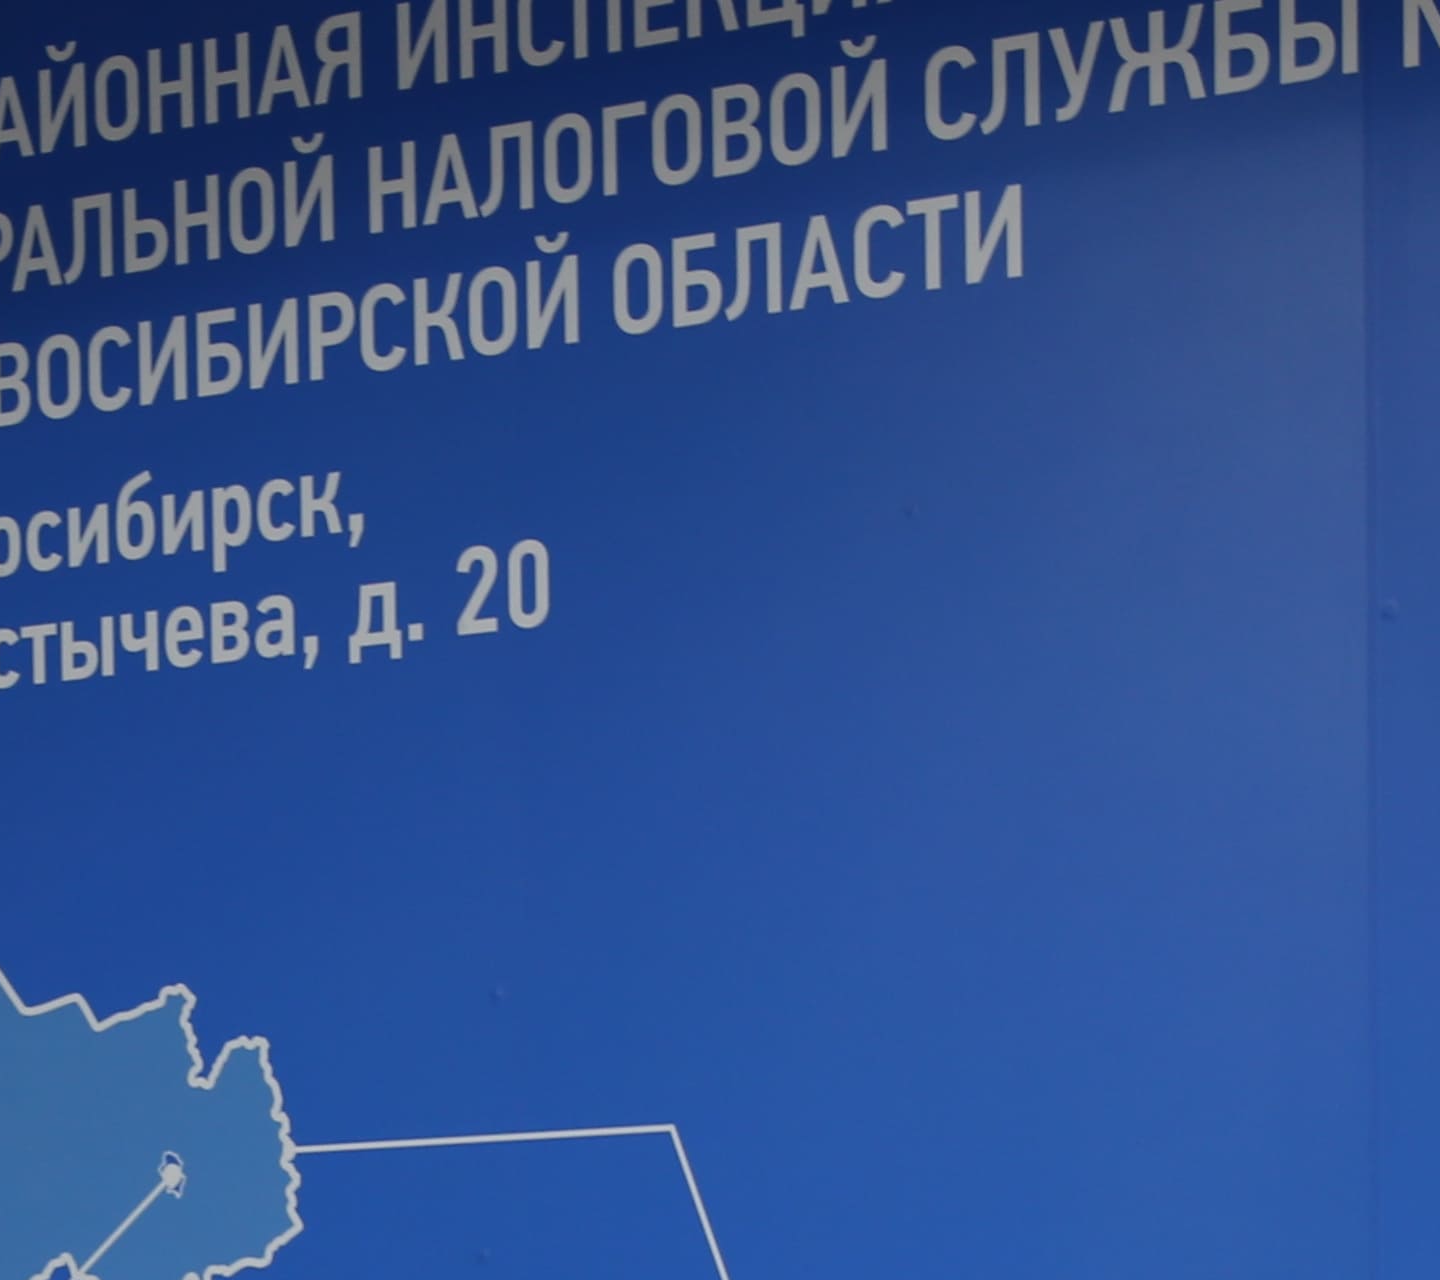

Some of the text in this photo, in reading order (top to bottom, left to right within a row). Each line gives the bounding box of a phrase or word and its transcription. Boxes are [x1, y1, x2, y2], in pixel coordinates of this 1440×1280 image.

[367, 35, 889, 234] НАЛОГОВОЙ
[924, 0, 1359, 140] СЛУЖБЫ
[612, 184, 1024, 335] ОБЛАСТИ
[348, 581, 424, 664] д.
[455, 538, 552, 635] 20
